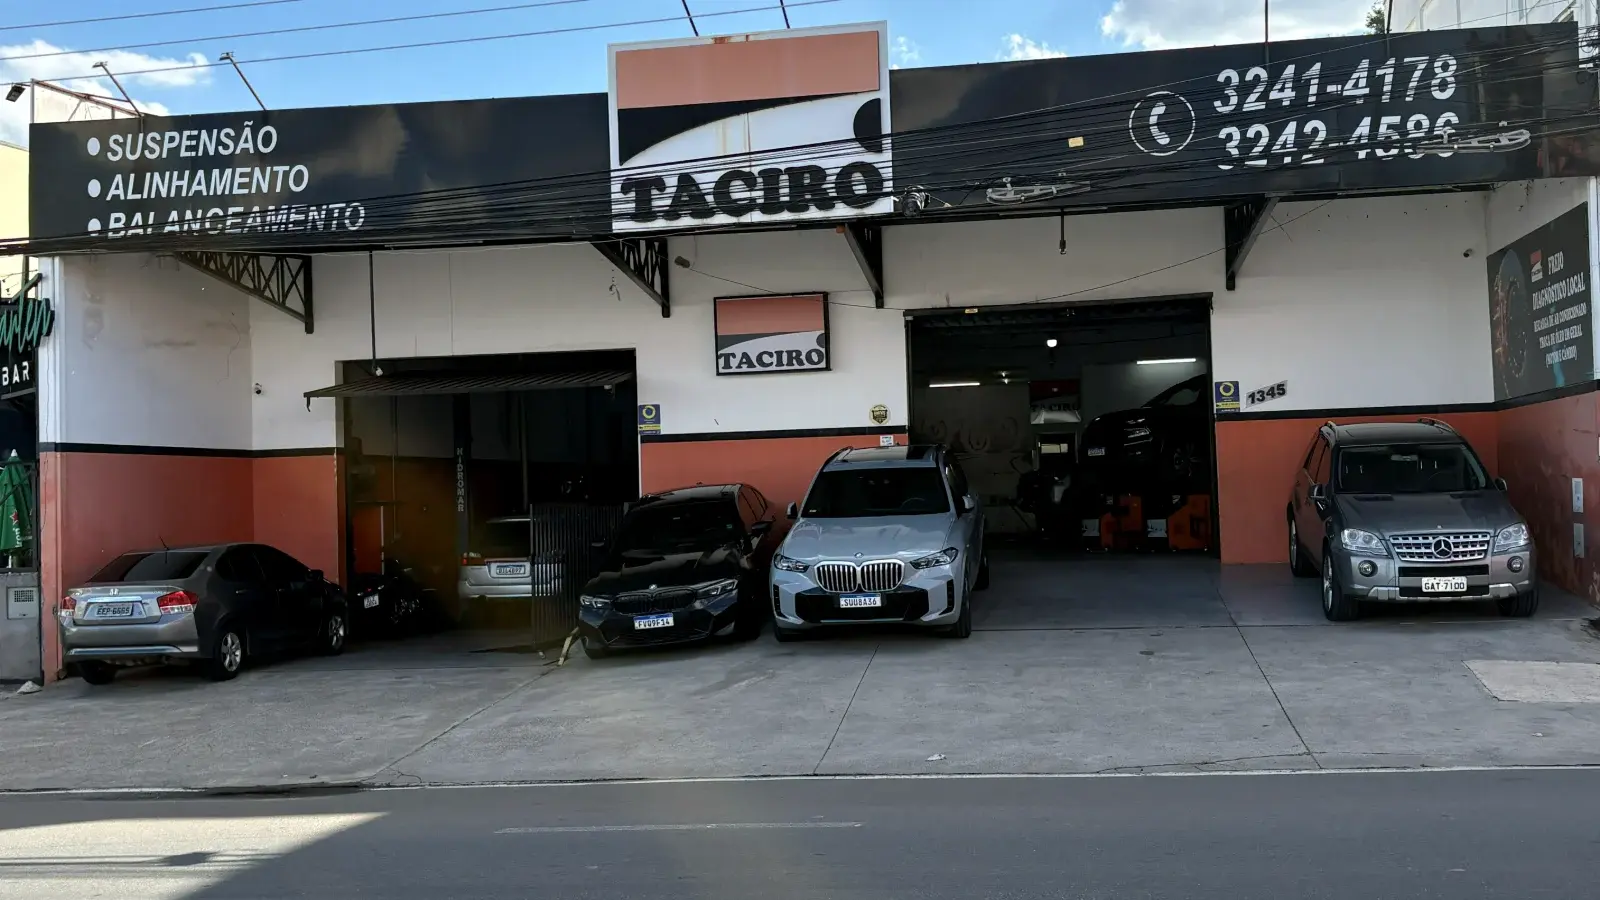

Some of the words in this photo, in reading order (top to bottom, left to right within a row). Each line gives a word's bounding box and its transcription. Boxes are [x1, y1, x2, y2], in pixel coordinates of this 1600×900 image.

[1213, 54, 1458, 113] 3241-4178
[106, 120, 278, 162] SUSPENSÃO
[105, 164, 309, 201] ALINHAMENTO
[620, 160, 884, 223] TACIRO
[107, 201, 366, 240] BALANCEAMENTO
[1567, 272, 1585, 297] LOCAL
[2, 361, 30, 386] BAR
[717, 348, 825, 371] TACIRO
[1248, 383, 1286, 404] 1345
[1424, 582, 1465, 591] GAT-7100
